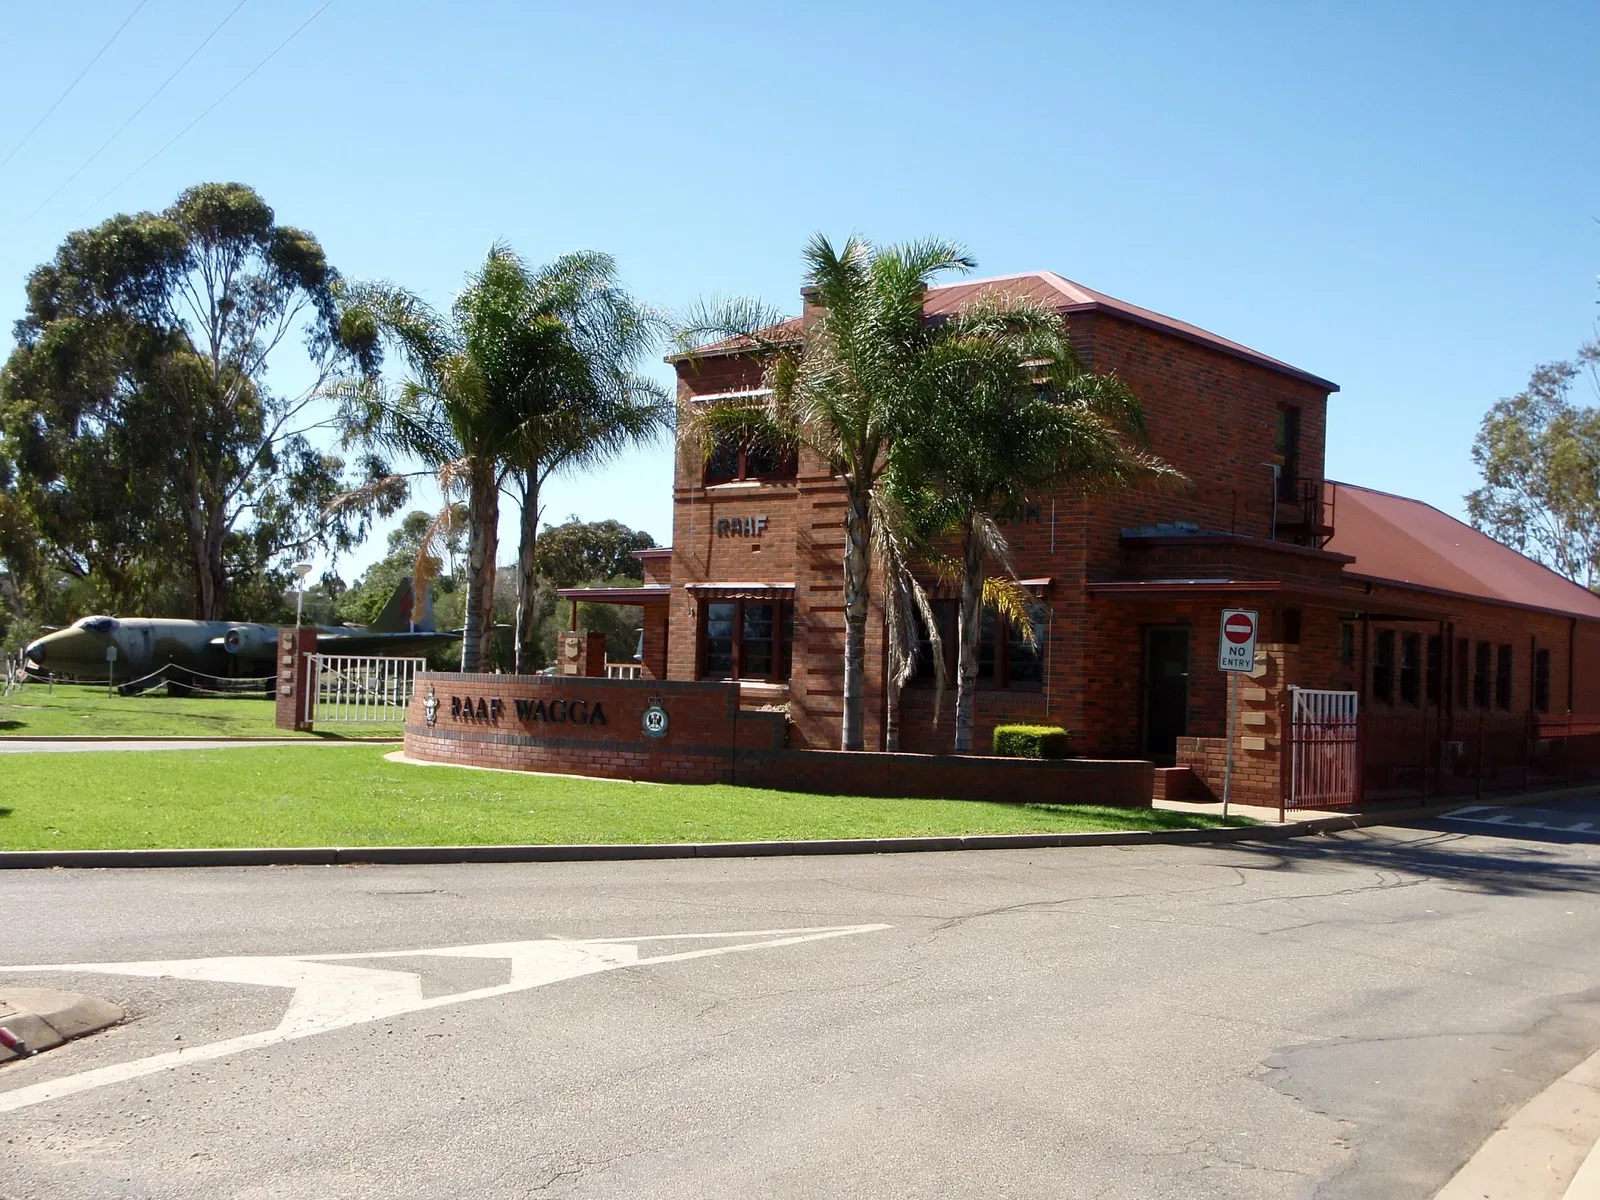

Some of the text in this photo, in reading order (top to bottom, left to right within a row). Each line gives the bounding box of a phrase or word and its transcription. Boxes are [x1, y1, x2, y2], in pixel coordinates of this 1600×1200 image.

[717, 515, 768, 537] RAAF
[1229, 646, 1246, 656] NO
[1222, 658, 1251, 667] ENTRY
[451, 696, 607, 725] RAAF WAGGA
